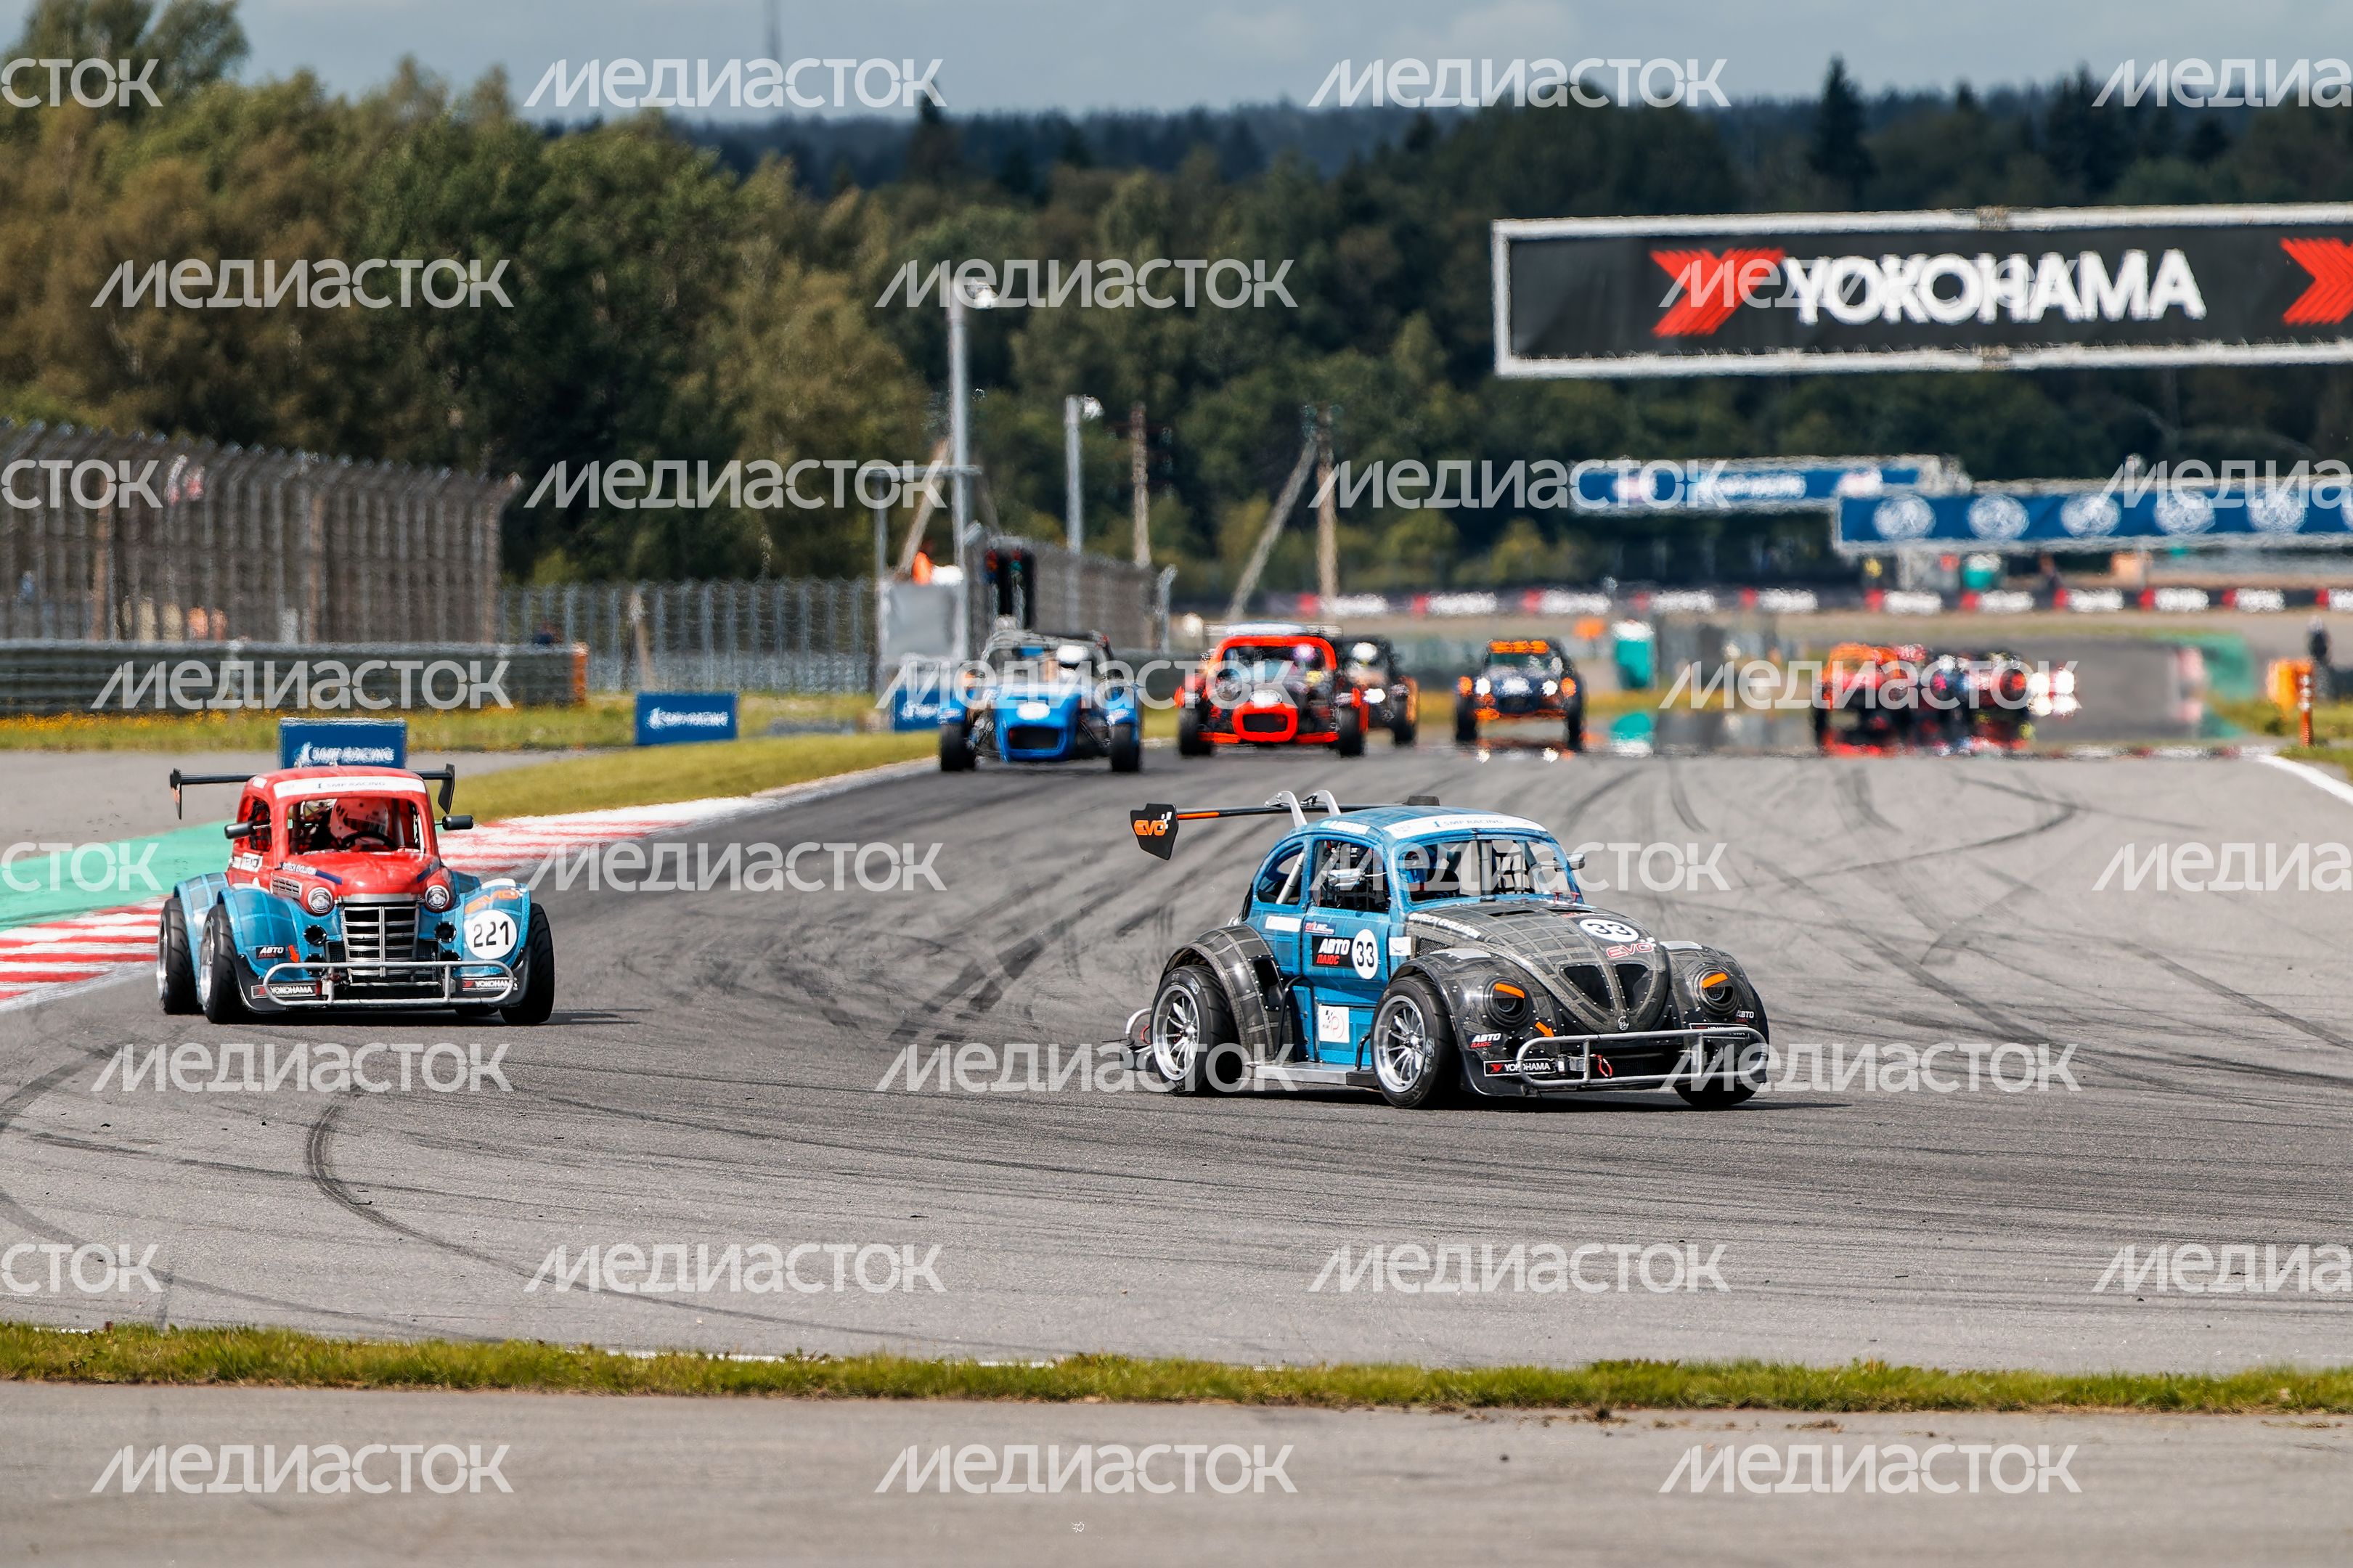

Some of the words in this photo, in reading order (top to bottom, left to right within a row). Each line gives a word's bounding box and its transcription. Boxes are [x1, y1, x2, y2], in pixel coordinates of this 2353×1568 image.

[1783, 248, 2206, 324] YOKOHAMA
[1134, 820, 1166, 836] EVO
[465, 889, 519, 914] EVO
[473, 920, 510, 948] 221
[1587, 923, 1633, 936] 33
[259, 946, 284, 955] АВТО
[1318, 938, 1351, 955] АВТО
[1356, 941, 1374, 967] 33
[1606, 943, 1654, 958] EVO
[1316, 954, 1340, 965] ПЛЮС
[1472, 1033, 1501, 1042] АВТО
